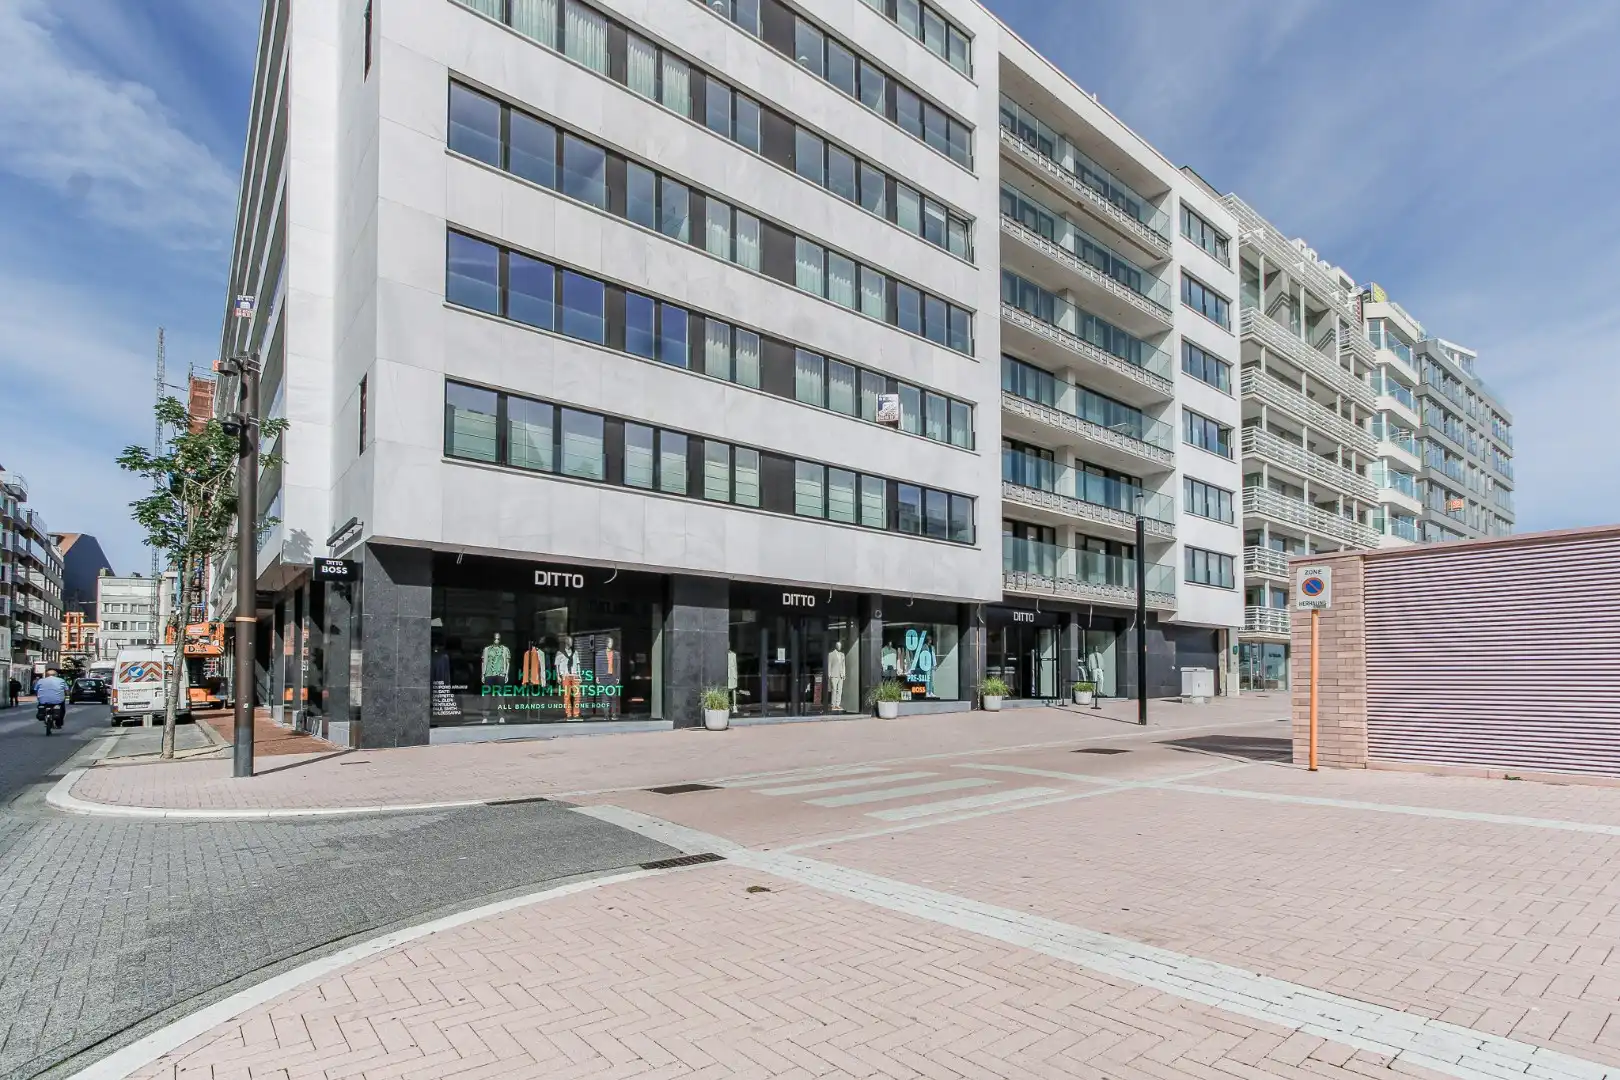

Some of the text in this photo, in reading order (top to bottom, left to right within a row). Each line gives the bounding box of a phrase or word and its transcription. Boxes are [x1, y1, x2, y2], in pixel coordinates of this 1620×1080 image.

[321, 565, 348, 575] BOSS
[534, 570, 584, 588] DITTO
[782, 592, 816, 607] DITTO
[1013, 611, 1034, 622] DITTO
[907, 674, 931, 682] PRE-SALE
[481, 684, 623, 697] PREMIUM HOTSPOT
